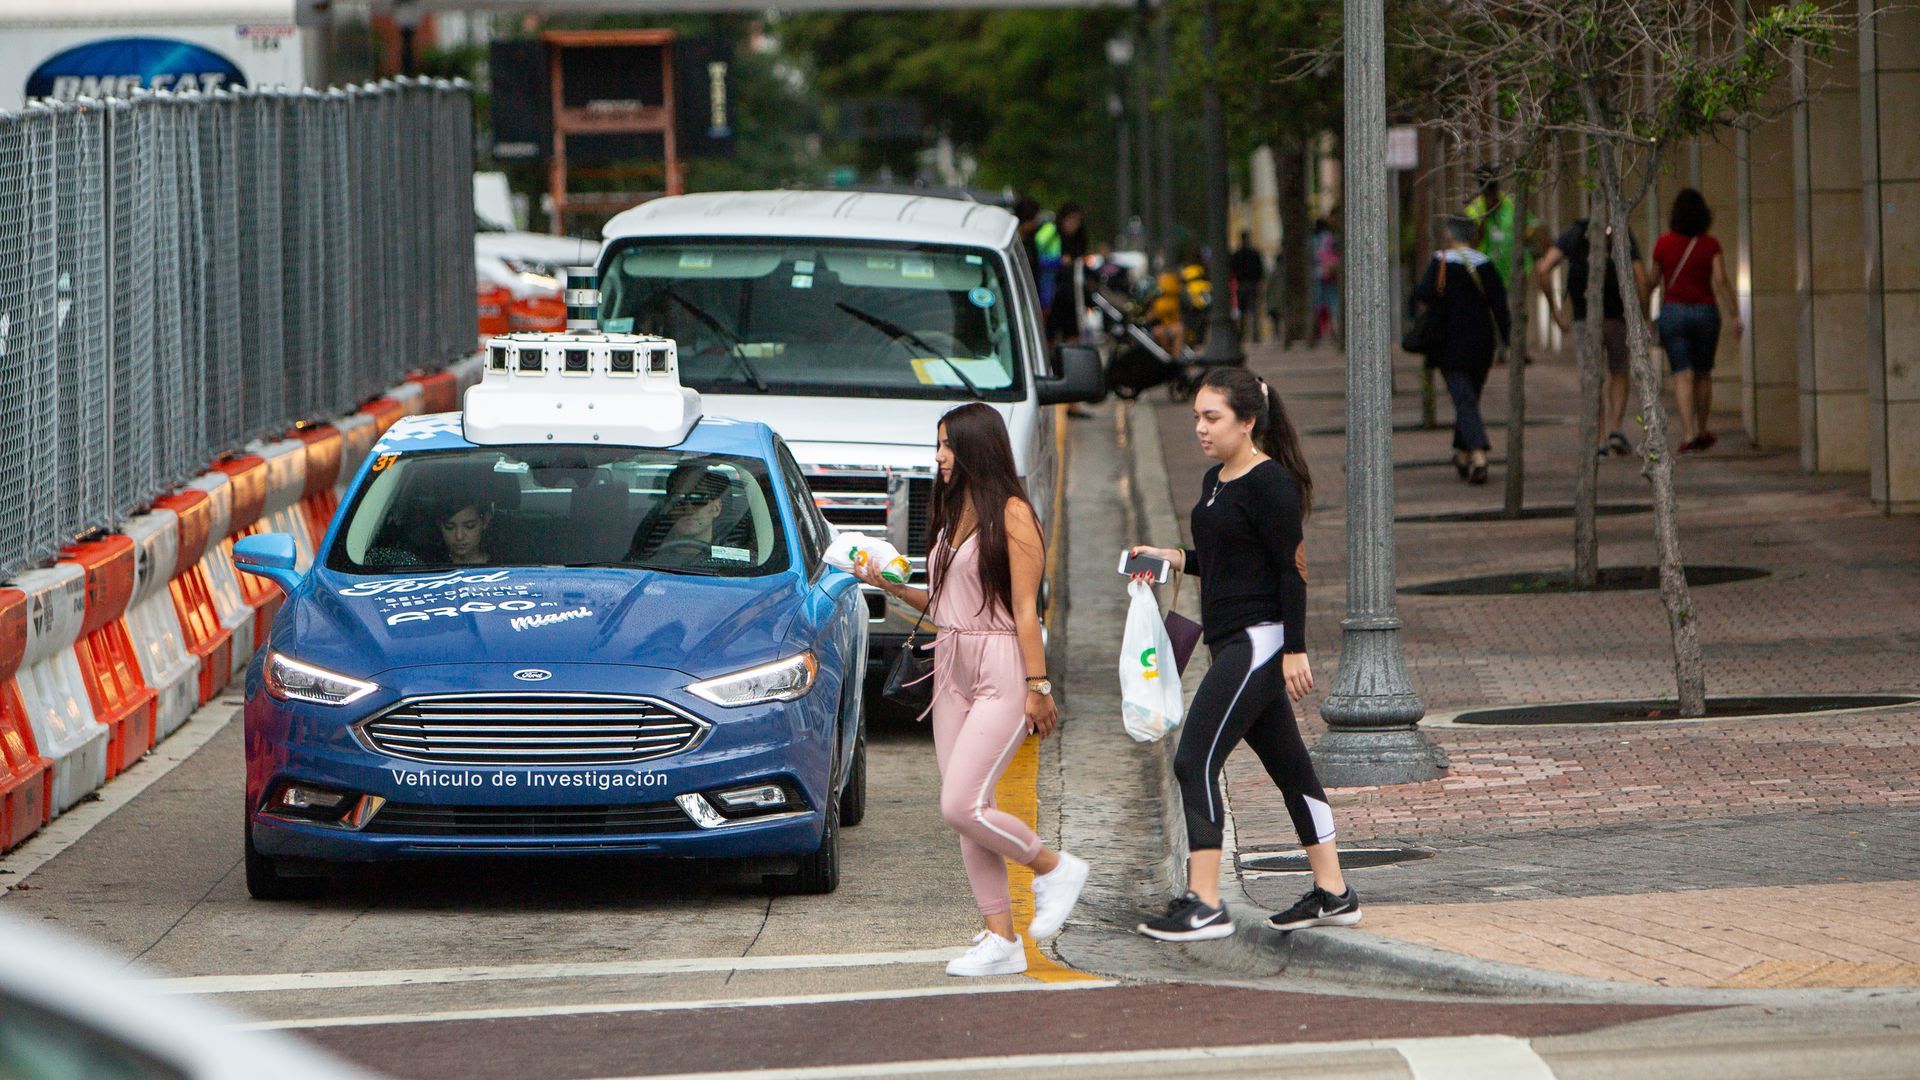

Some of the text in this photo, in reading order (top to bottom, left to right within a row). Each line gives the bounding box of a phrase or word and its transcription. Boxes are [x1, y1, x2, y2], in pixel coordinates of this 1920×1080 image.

[372, 455, 398, 471] 31
[338, 570, 510, 597] Ford
[385, 585, 528, 604] SELF-DRIVING
[387, 590, 529, 609] TEST VEHICLE
[386, 600, 537, 627] ARGO
[510, 606, 594, 633] Miami
[391, 768, 669, 790] Vehiculo de Investigación
